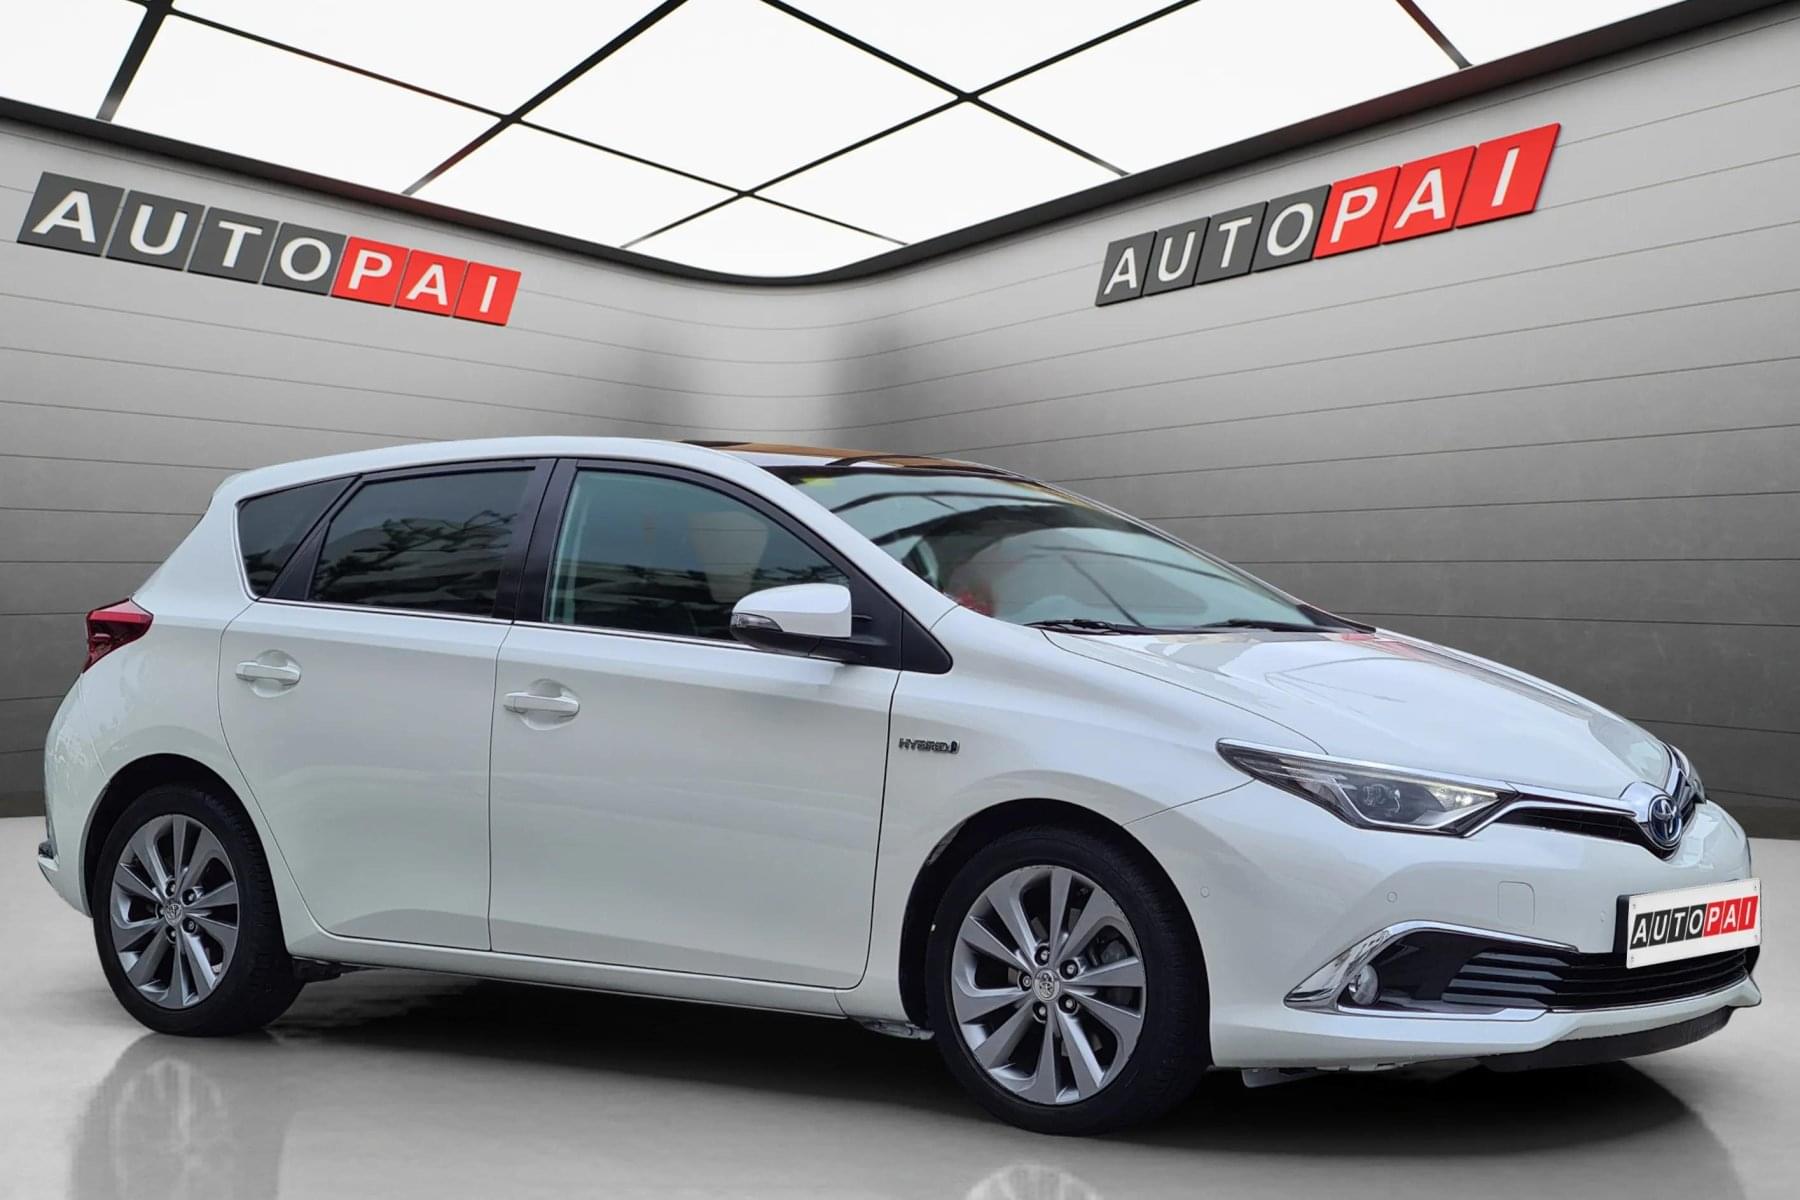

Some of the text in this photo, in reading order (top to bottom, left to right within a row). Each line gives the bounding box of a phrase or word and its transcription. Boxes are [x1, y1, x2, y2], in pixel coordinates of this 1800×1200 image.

[32, 189, 499, 313] AUTOPAI
[1103, 147, 1519, 295] AUTOPAI
[1632, 900, 1752, 945] AUTOPAI
